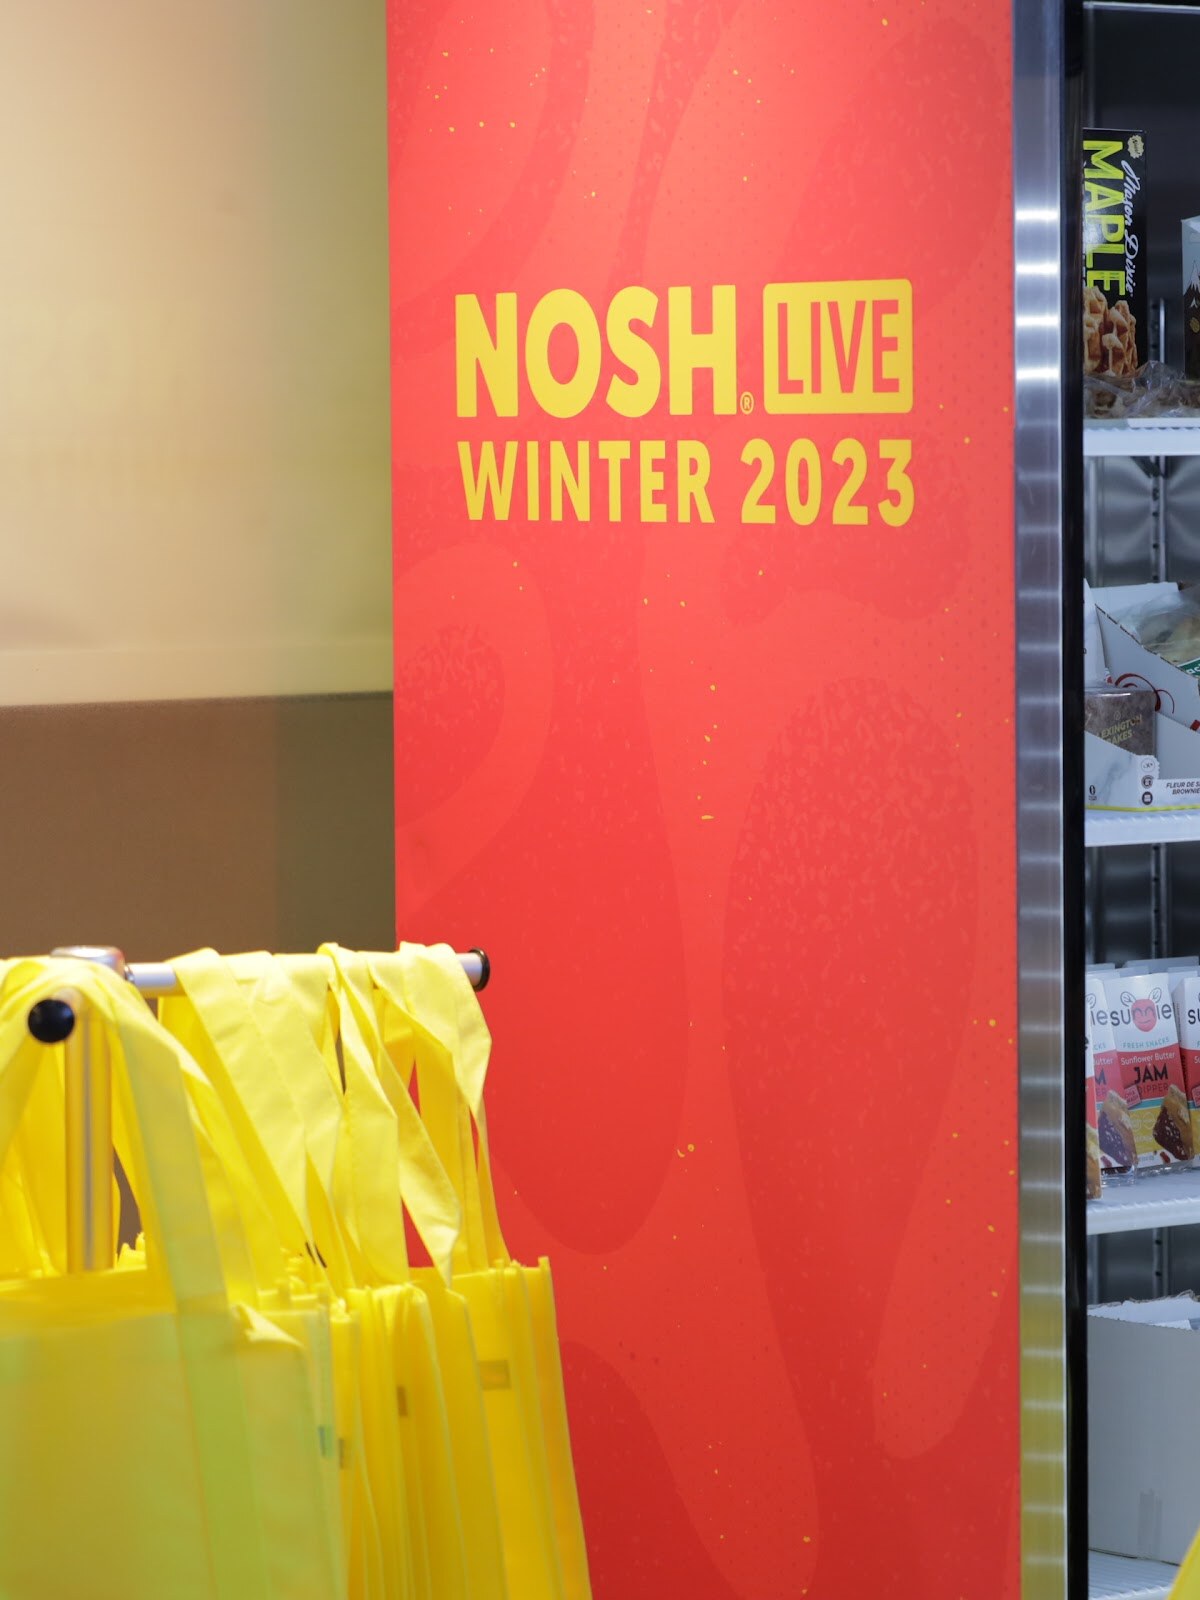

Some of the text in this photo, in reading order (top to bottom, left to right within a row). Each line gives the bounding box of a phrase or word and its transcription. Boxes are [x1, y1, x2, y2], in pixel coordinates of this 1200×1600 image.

[1083, 140, 1126, 296] MAPLE
[1121, 159, 1141, 226] Mason
[777, 299, 900, 395] LIVE
[457, 437, 915, 528] WINTER 2023
[1120, 1051, 1176, 1066] Sunflower Butter
[1123, 1038, 1170, 1049] FRESH SNACKS
[1134, 1063, 1169, 1085] JAM
